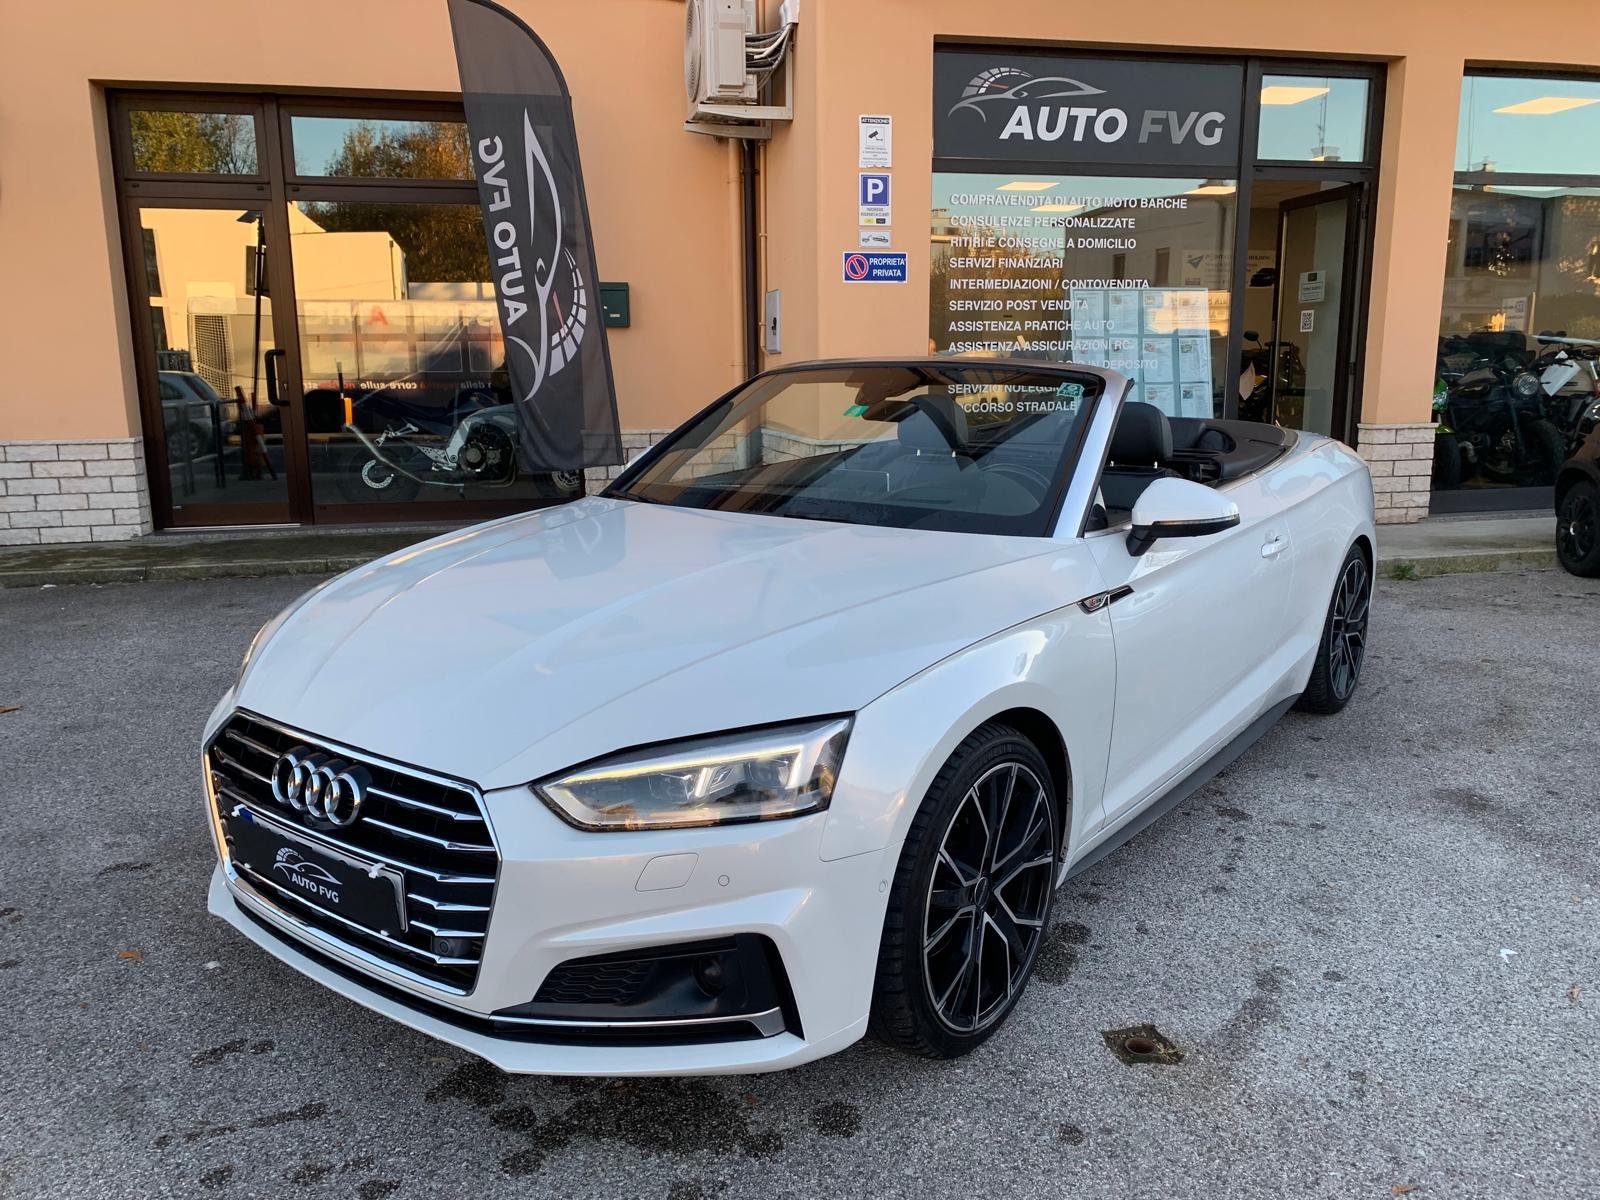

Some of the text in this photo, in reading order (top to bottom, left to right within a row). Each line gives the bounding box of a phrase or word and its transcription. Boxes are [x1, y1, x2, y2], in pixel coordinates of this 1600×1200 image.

[999, 105, 1226, 146] AUTO FVG
[867, 179, 884, 203] P
[950, 194, 1188, 209] COMPRAVENDITA DI AUTO MOTO BARCHE
[950, 215, 1136, 229] CONSULENZE PERSONALIZZATE
[950, 236, 985, 248] RITIRI
[998, 237, 1065, 249] CONSEGNE
[1067, 238, 1075, 249] A
[1078, 238, 1137, 249] DOMICILIO
[949, 257, 1064, 269] SERVIZI FINANZIARI
[872, 269, 902, 277] PRIVATA
[950, 278, 1052, 290] INTERMEDIAZIONI
[1061, 279, 1149, 290] CONTOVENDITA
[949, 300, 1089, 311] SERVIZIO POST VENDITA
[948, 319, 1115, 332] ASSISTENZA PRATICHE AUTO
[948, 339, 1130, 353] ASSISTENZA ASSICURAZIONI RC
[1103, 359, 1159, 370] DEPOSITO
[947, 384, 1002, 395] SERVIZIO
[1016, 400, 1076, 412] STRADALE
[291, 872, 339, 904] AUTO FVG
